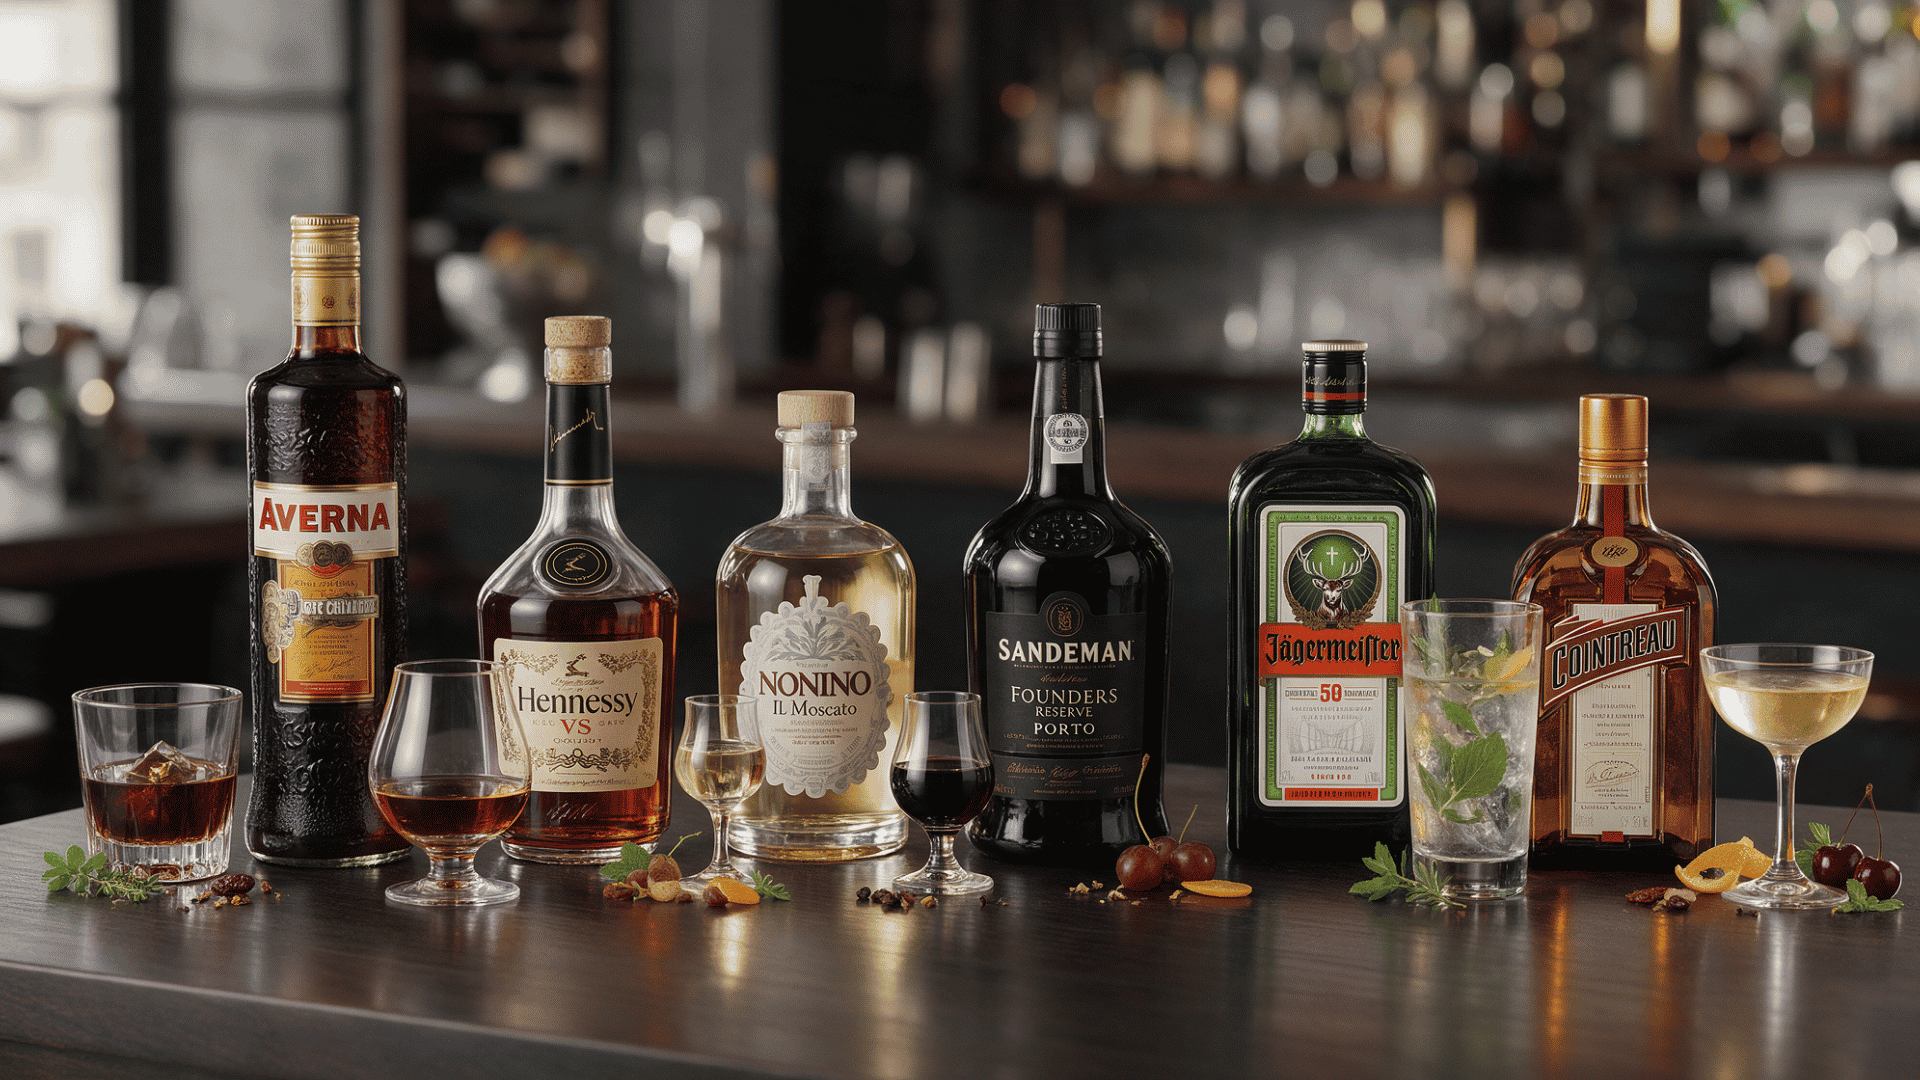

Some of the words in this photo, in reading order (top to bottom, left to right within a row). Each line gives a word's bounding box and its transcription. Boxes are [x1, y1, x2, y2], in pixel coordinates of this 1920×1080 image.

[259, 497, 391, 532] AVERNA
[998, 638, 1133, 663] SANDEMAN
[1552, 619, 1676, 690] COINTREAU
[759, 670, 872, 697] NONINO
[1011, 685, 1117, 704] FOUNDERS
[518, 686, 638, 717] Hennessy
[790, 699, 857, 716] Moscato
[1035, 706, 1093, 717] RESERVE
[559, 718, 592, 735] VS
[1034, 722, 1095, 735] PORTO
